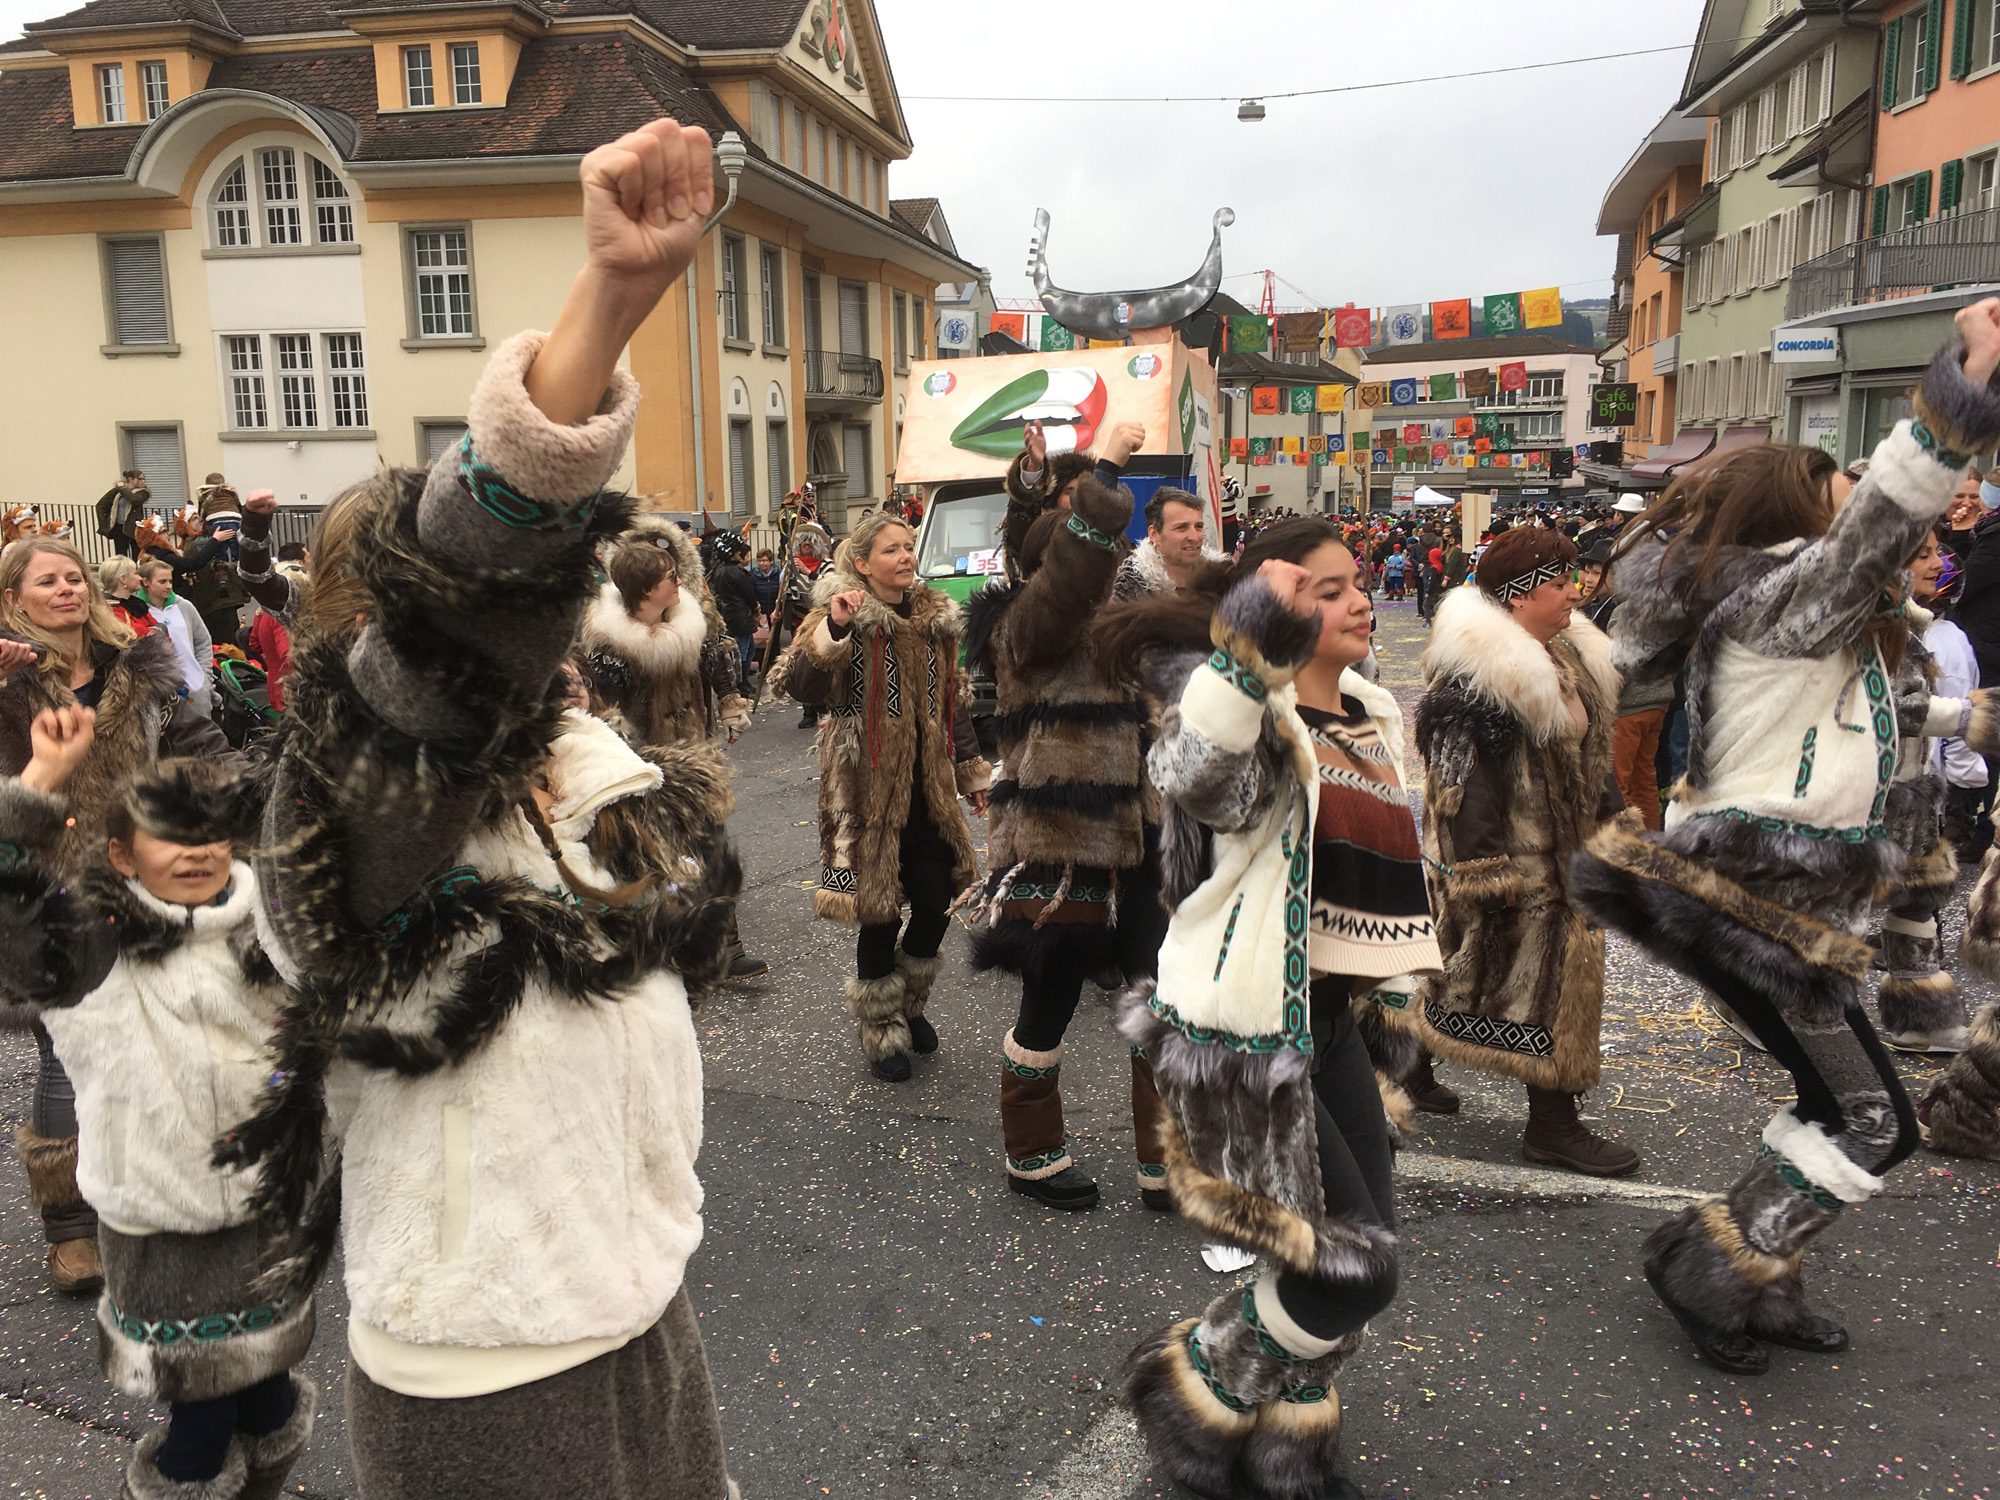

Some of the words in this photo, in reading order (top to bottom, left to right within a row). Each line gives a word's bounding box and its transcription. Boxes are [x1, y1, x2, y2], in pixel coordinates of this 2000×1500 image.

[1777, 337, 1834, 351] CONCORDIA
[1593, 388, 1627, 403] Café
[1599, 402, 1635, 424] Bijou
[976, 558, 998, 572] 35
